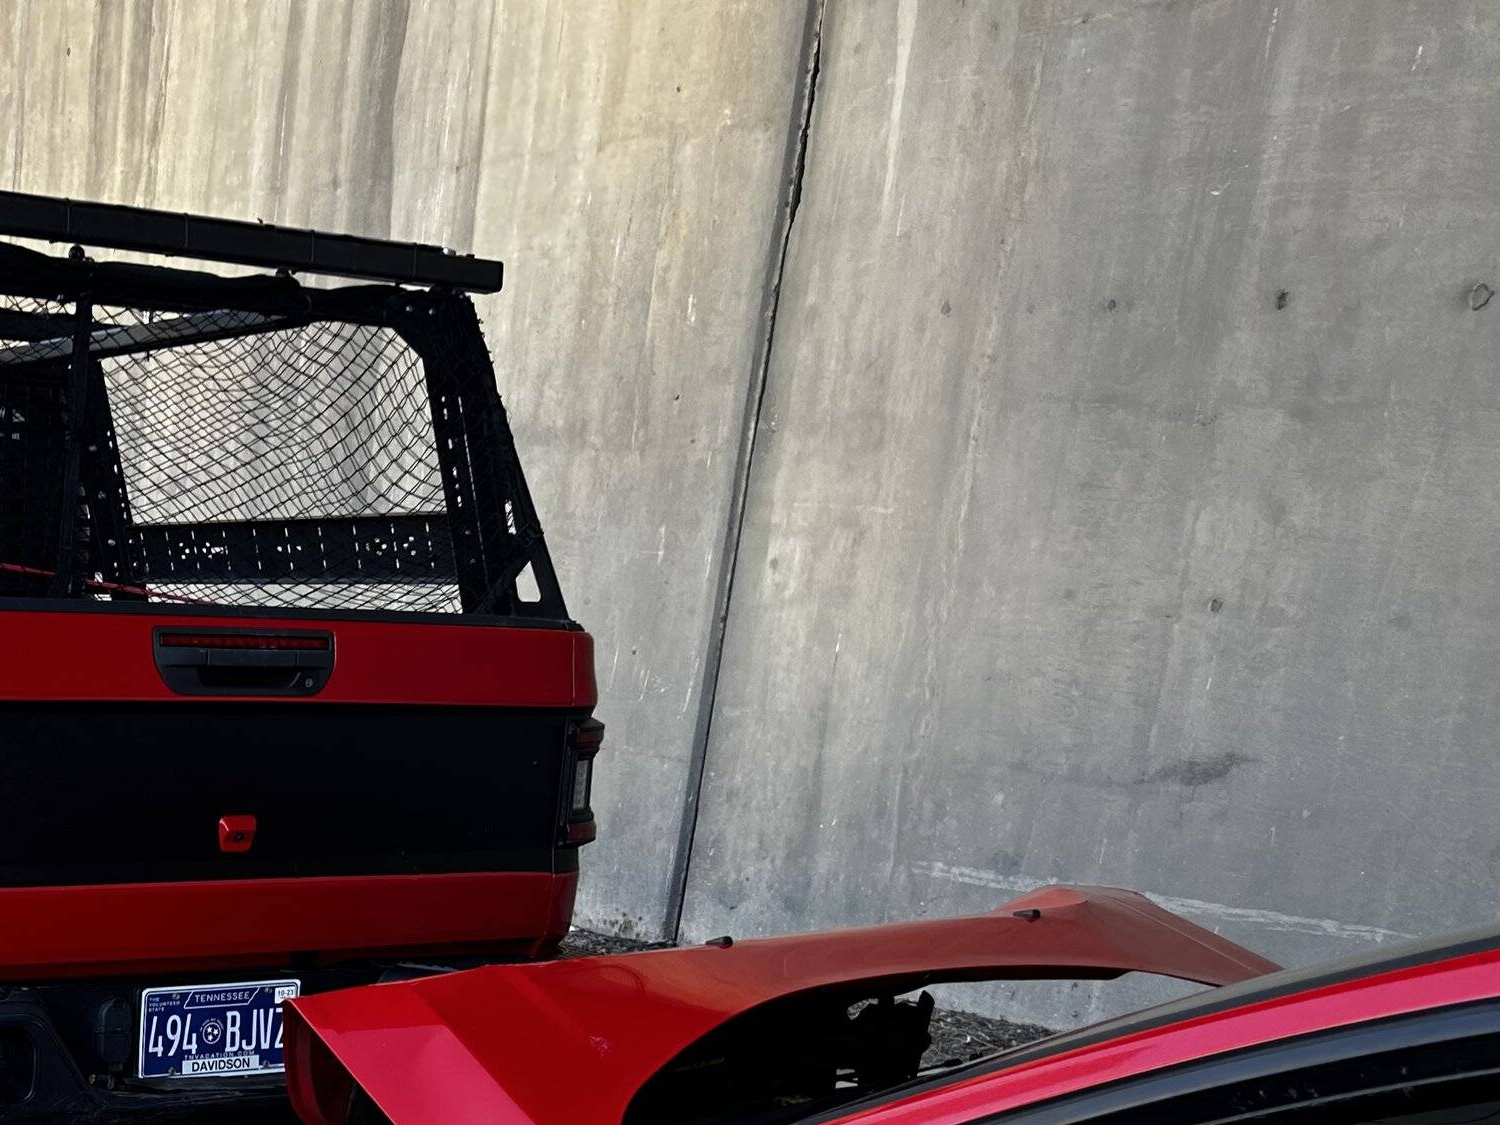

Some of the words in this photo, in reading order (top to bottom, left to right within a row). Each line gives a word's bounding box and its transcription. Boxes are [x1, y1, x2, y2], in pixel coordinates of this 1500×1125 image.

[194, 990, 250, 1004] TENNESSEE
[148, 1012, 198, 1058] 494
[191, 1057, 251, 1073] DAVIDSON
